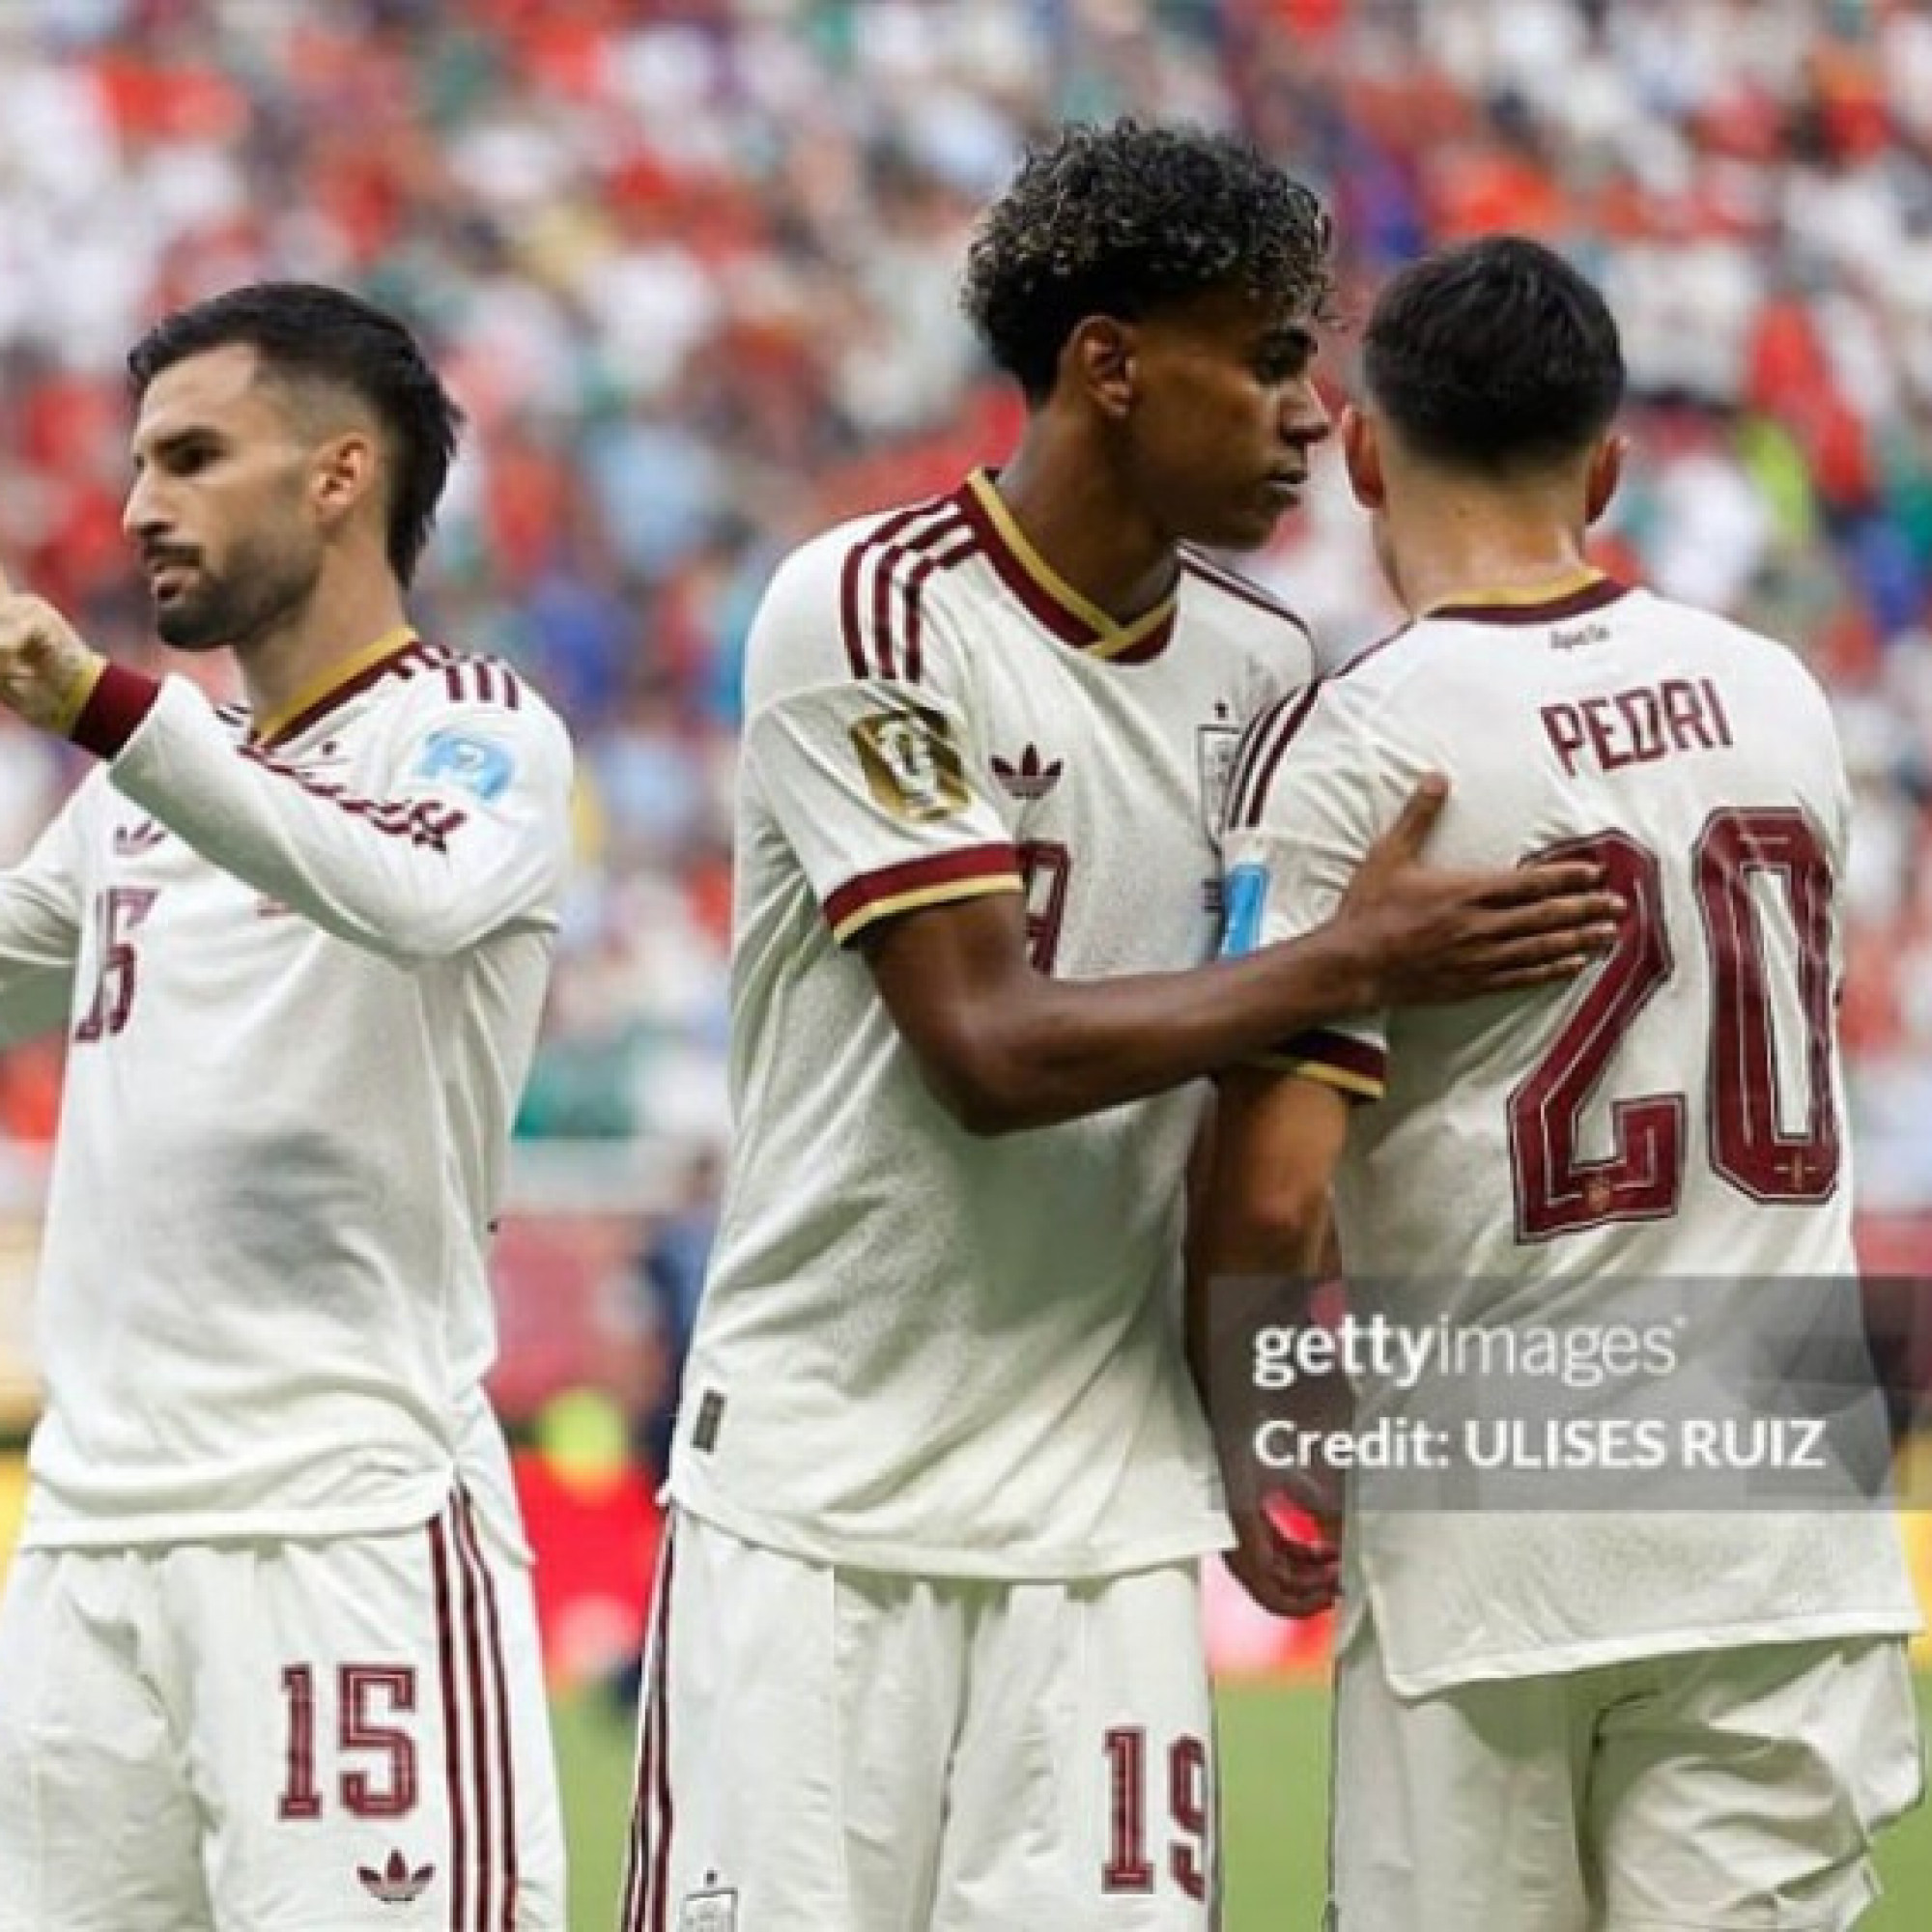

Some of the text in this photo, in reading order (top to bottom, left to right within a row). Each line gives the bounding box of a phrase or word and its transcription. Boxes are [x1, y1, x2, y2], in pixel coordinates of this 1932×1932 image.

[1539, 675, 1734, 778] PEDRI
[1023, 840, 1069, 976] 9
[1507, 806, 1840, 1244] 20
[276, 1662, 419, 1821] 15
